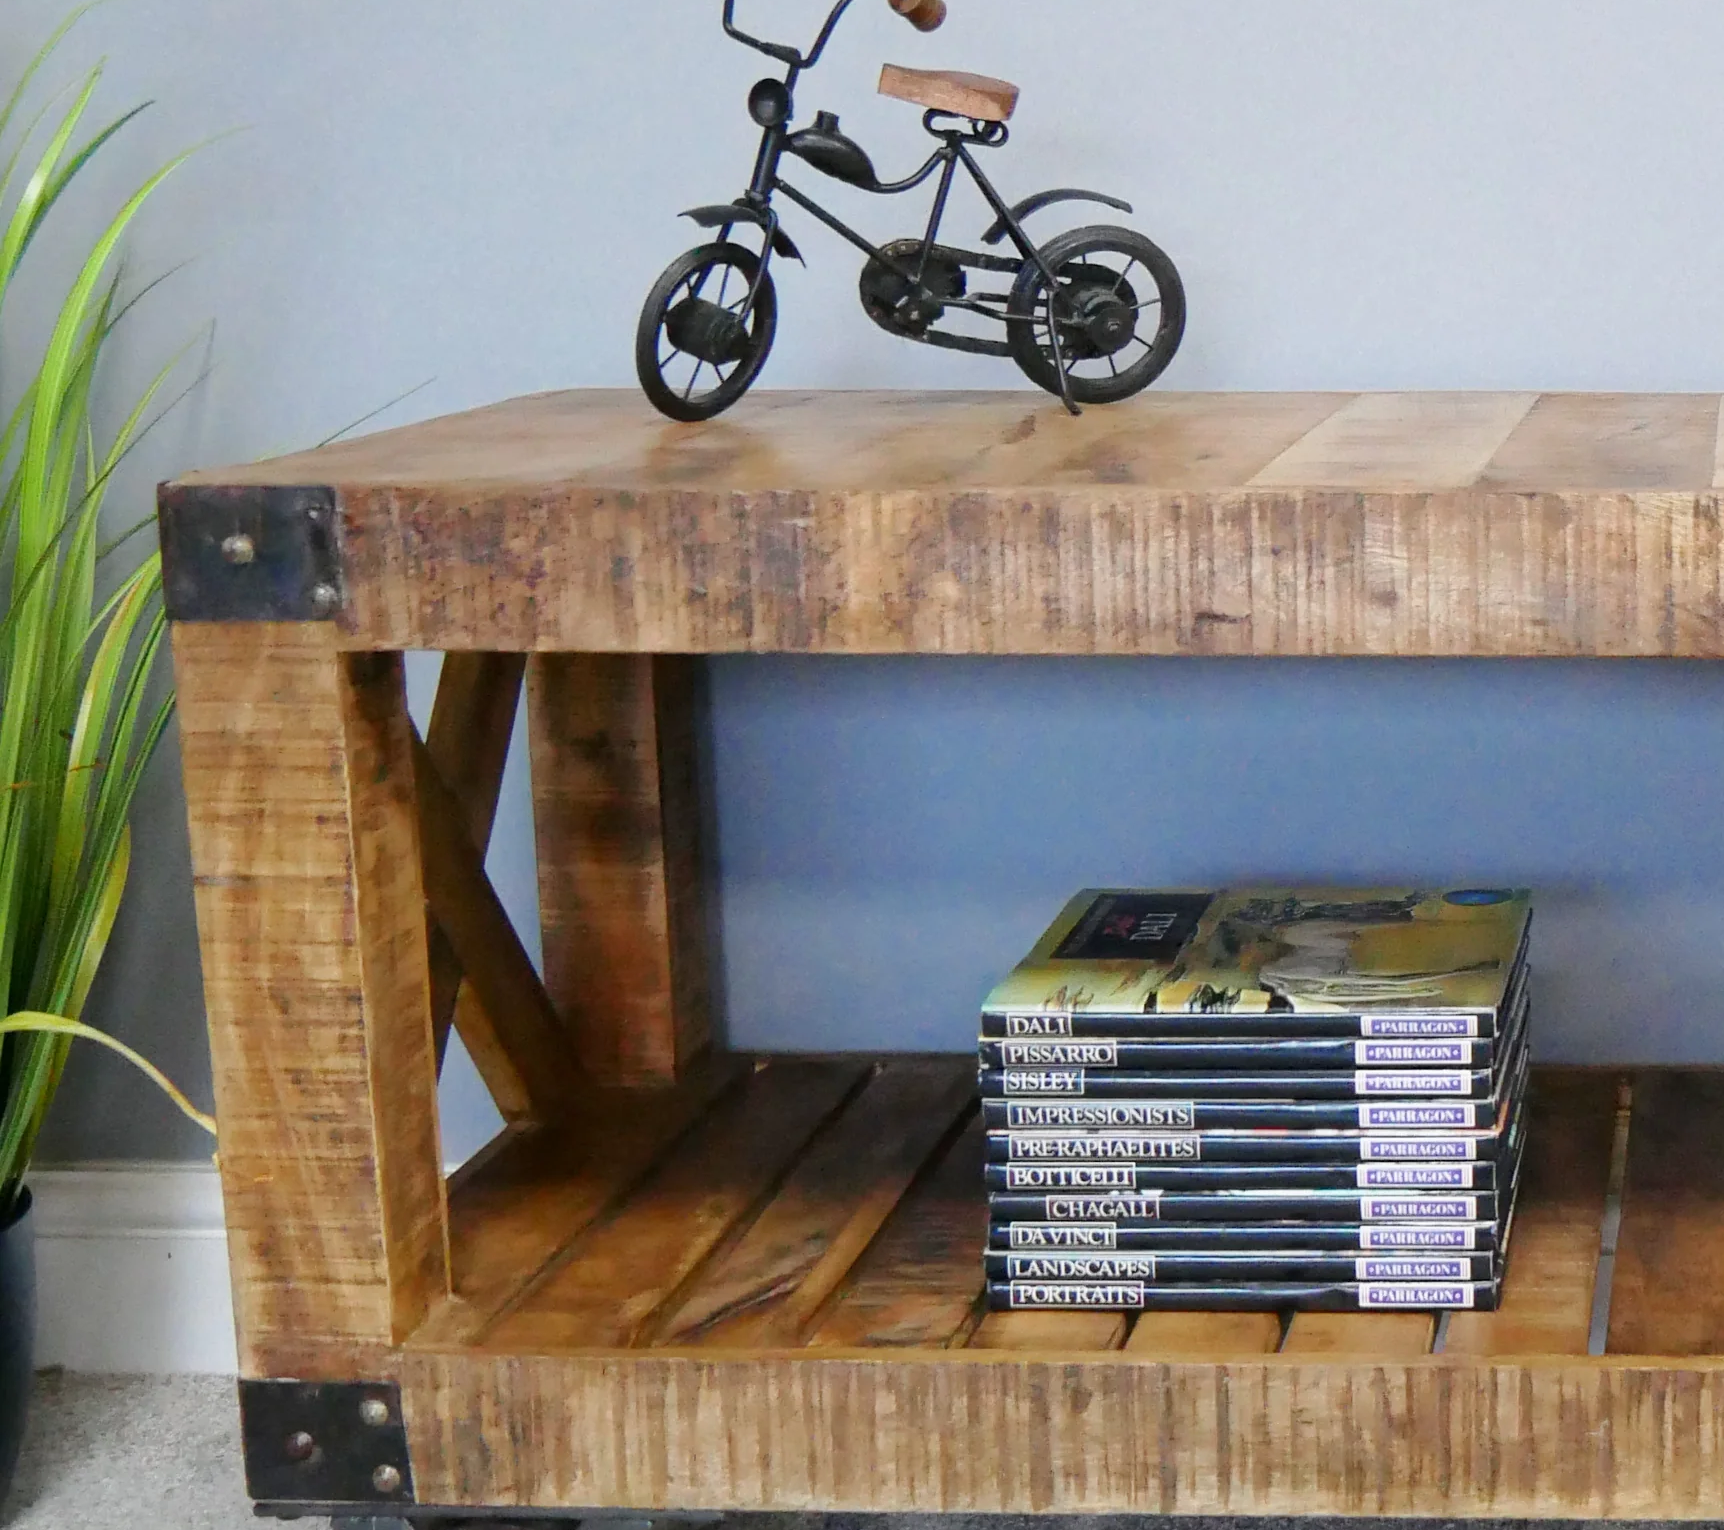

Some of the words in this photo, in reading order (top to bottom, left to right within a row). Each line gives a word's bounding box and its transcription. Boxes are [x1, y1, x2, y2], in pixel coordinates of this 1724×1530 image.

[1012, 1017, 1066, 1035] DALI
[1380, 1021, 1458, 1034] PARRAGON
[1009, 1044, 1112, 1064] PISSARRO
[1374, 1046, 1452, 1060] PARRAGON
[1008, 1071, 1078, 1090] SISLEY
[1374, 1075, 1452, 1089] PARRAGON
[1016, 1106, 1189, 1125] IMPRESSIONISTS
[1379, 1109, 1455, 1123] PARRAGON
[1379, 1143, 1457, 1156] PARRAGON
[1013, 1167, 1130, 1186] BOTTICELLI
[1375, 1170, 1453, 1184] PARRAGON
[1052, 1200, 1154, 1218] CHAGALL
[1380, 1203, 1458, 1216] PARRAGON
[1016, 1227, 1048, 1245] DA
[1050, 1227, 1112, 1245] VINCI
[1379, 1232, 1456, 1246] PARRAGON
[1014, 1259, 1151, 1278] LANDSCAPES
[1375, 1263, 1452, 1276] PARRAGON
[1018, 1284, 1139, 1305] PORTRAITS
[1378, 1289, 1455, 1303] PARRAGON
